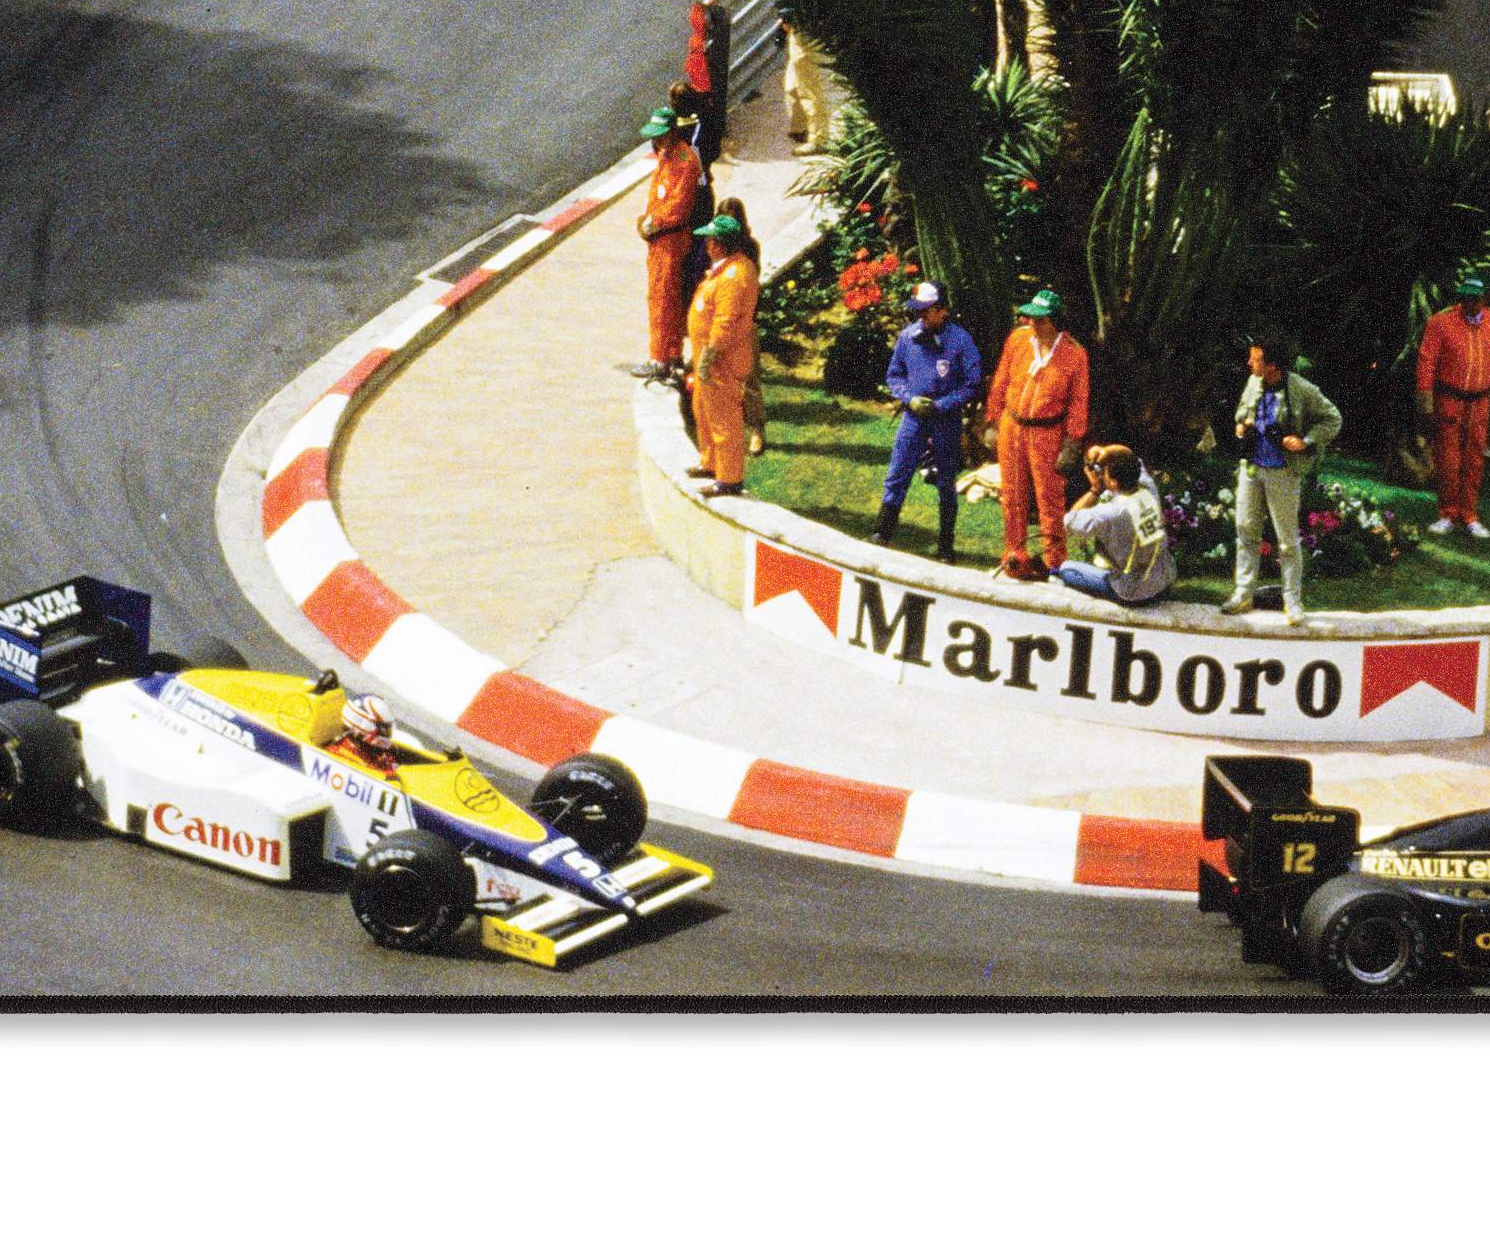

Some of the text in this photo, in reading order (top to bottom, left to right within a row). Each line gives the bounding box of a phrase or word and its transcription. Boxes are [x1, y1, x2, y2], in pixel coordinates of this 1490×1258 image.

[847, 574, 1344, 721] Marlboro
[310, 756, 374, 806] Mobil
[152, 802, 282, 867] Canon
[365, 817, 389, 849] 5
[562, 850, 602, 880] 5
[1281, 842, 1317, 875] 12
[1361, 854, 1468, 880] RENAULT
